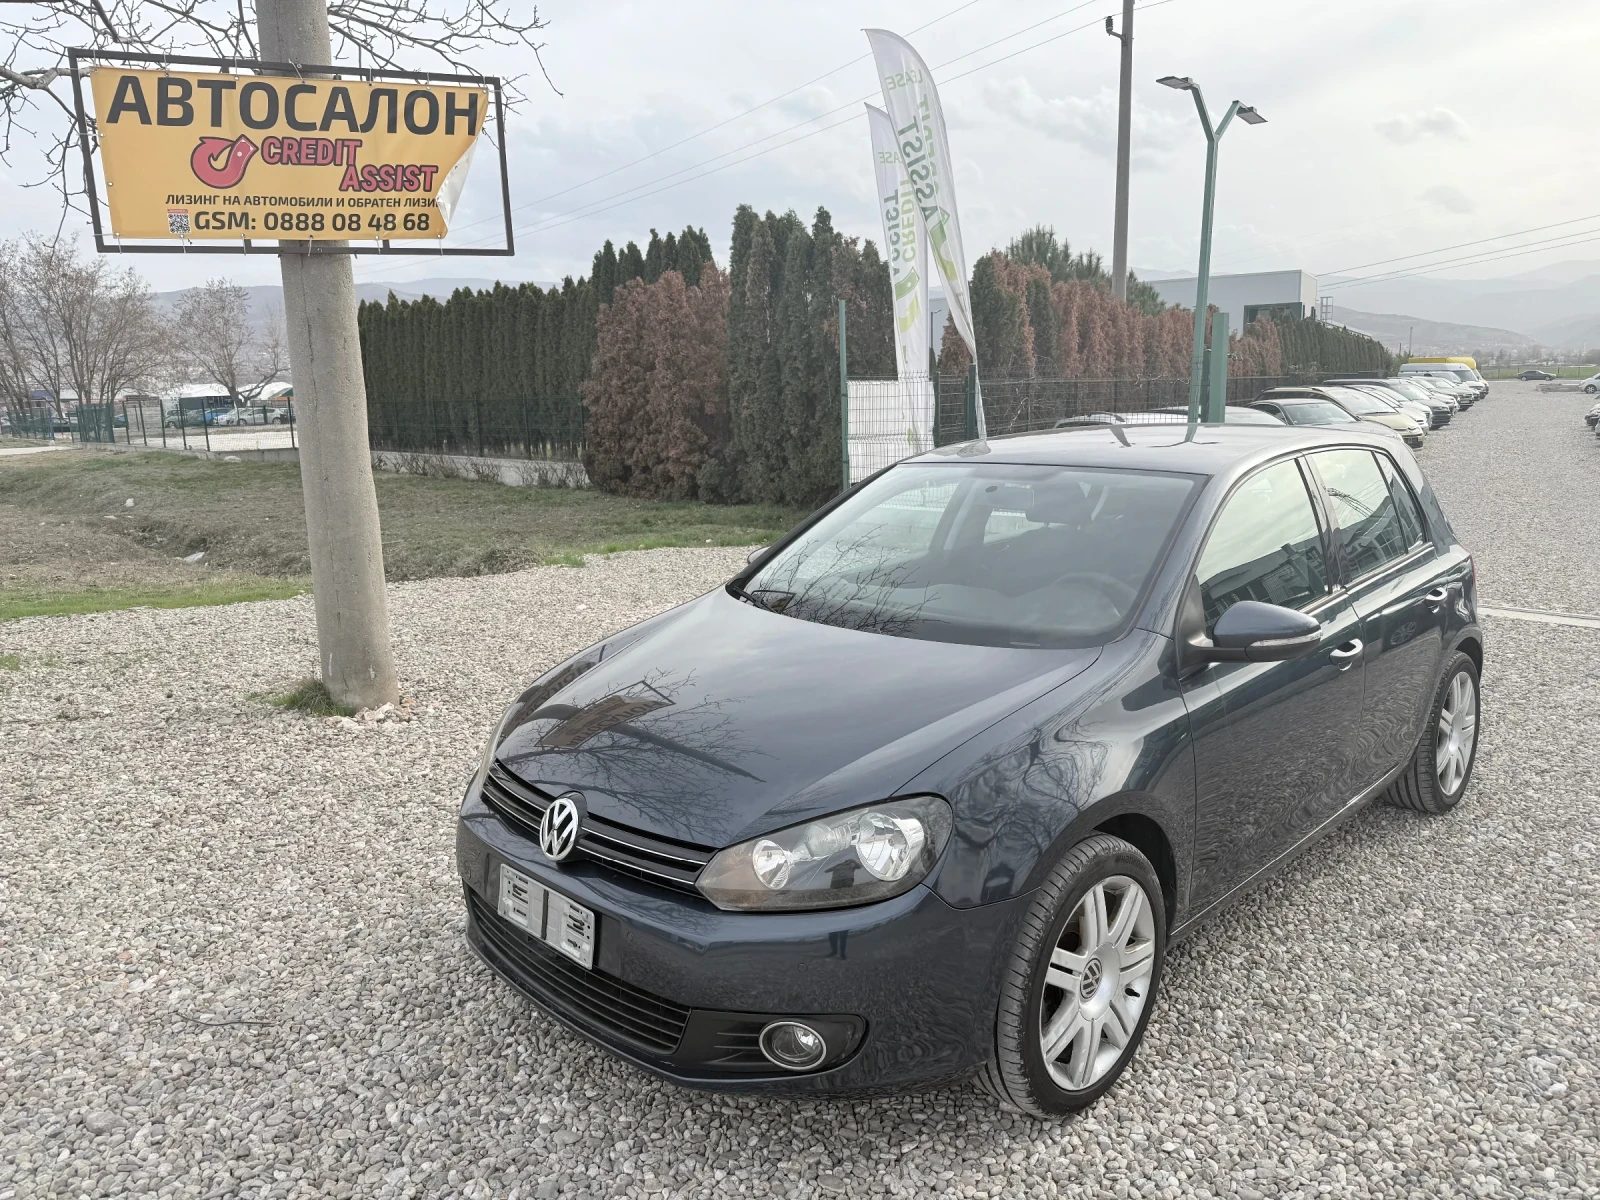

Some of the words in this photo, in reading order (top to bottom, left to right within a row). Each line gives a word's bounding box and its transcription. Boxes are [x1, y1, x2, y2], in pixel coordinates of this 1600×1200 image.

[105, 75, 479, 137] АВТОСАЛОН
[261, 136, 362, 166] CREDIT
[339, 164, 439, 193] ASSIST
[165, 194, 220, 205] ЛИЗИНГ
[223, 195, 241, 206] НА
[244, 196, 333, 207] АВТОМОБИЛИ
[336, 198, 345, 207] И
[348, 198, 401, 208] ОБРАТЕН
[194, 211, 256, 230] GSM:
[263, 212, 325, 231] 0888
[332, 213, 361, 231] 08
[367, 213, 397, 231] 48
[403, 213, 430, 231] 68
[541, 799, 578, 861] VW
